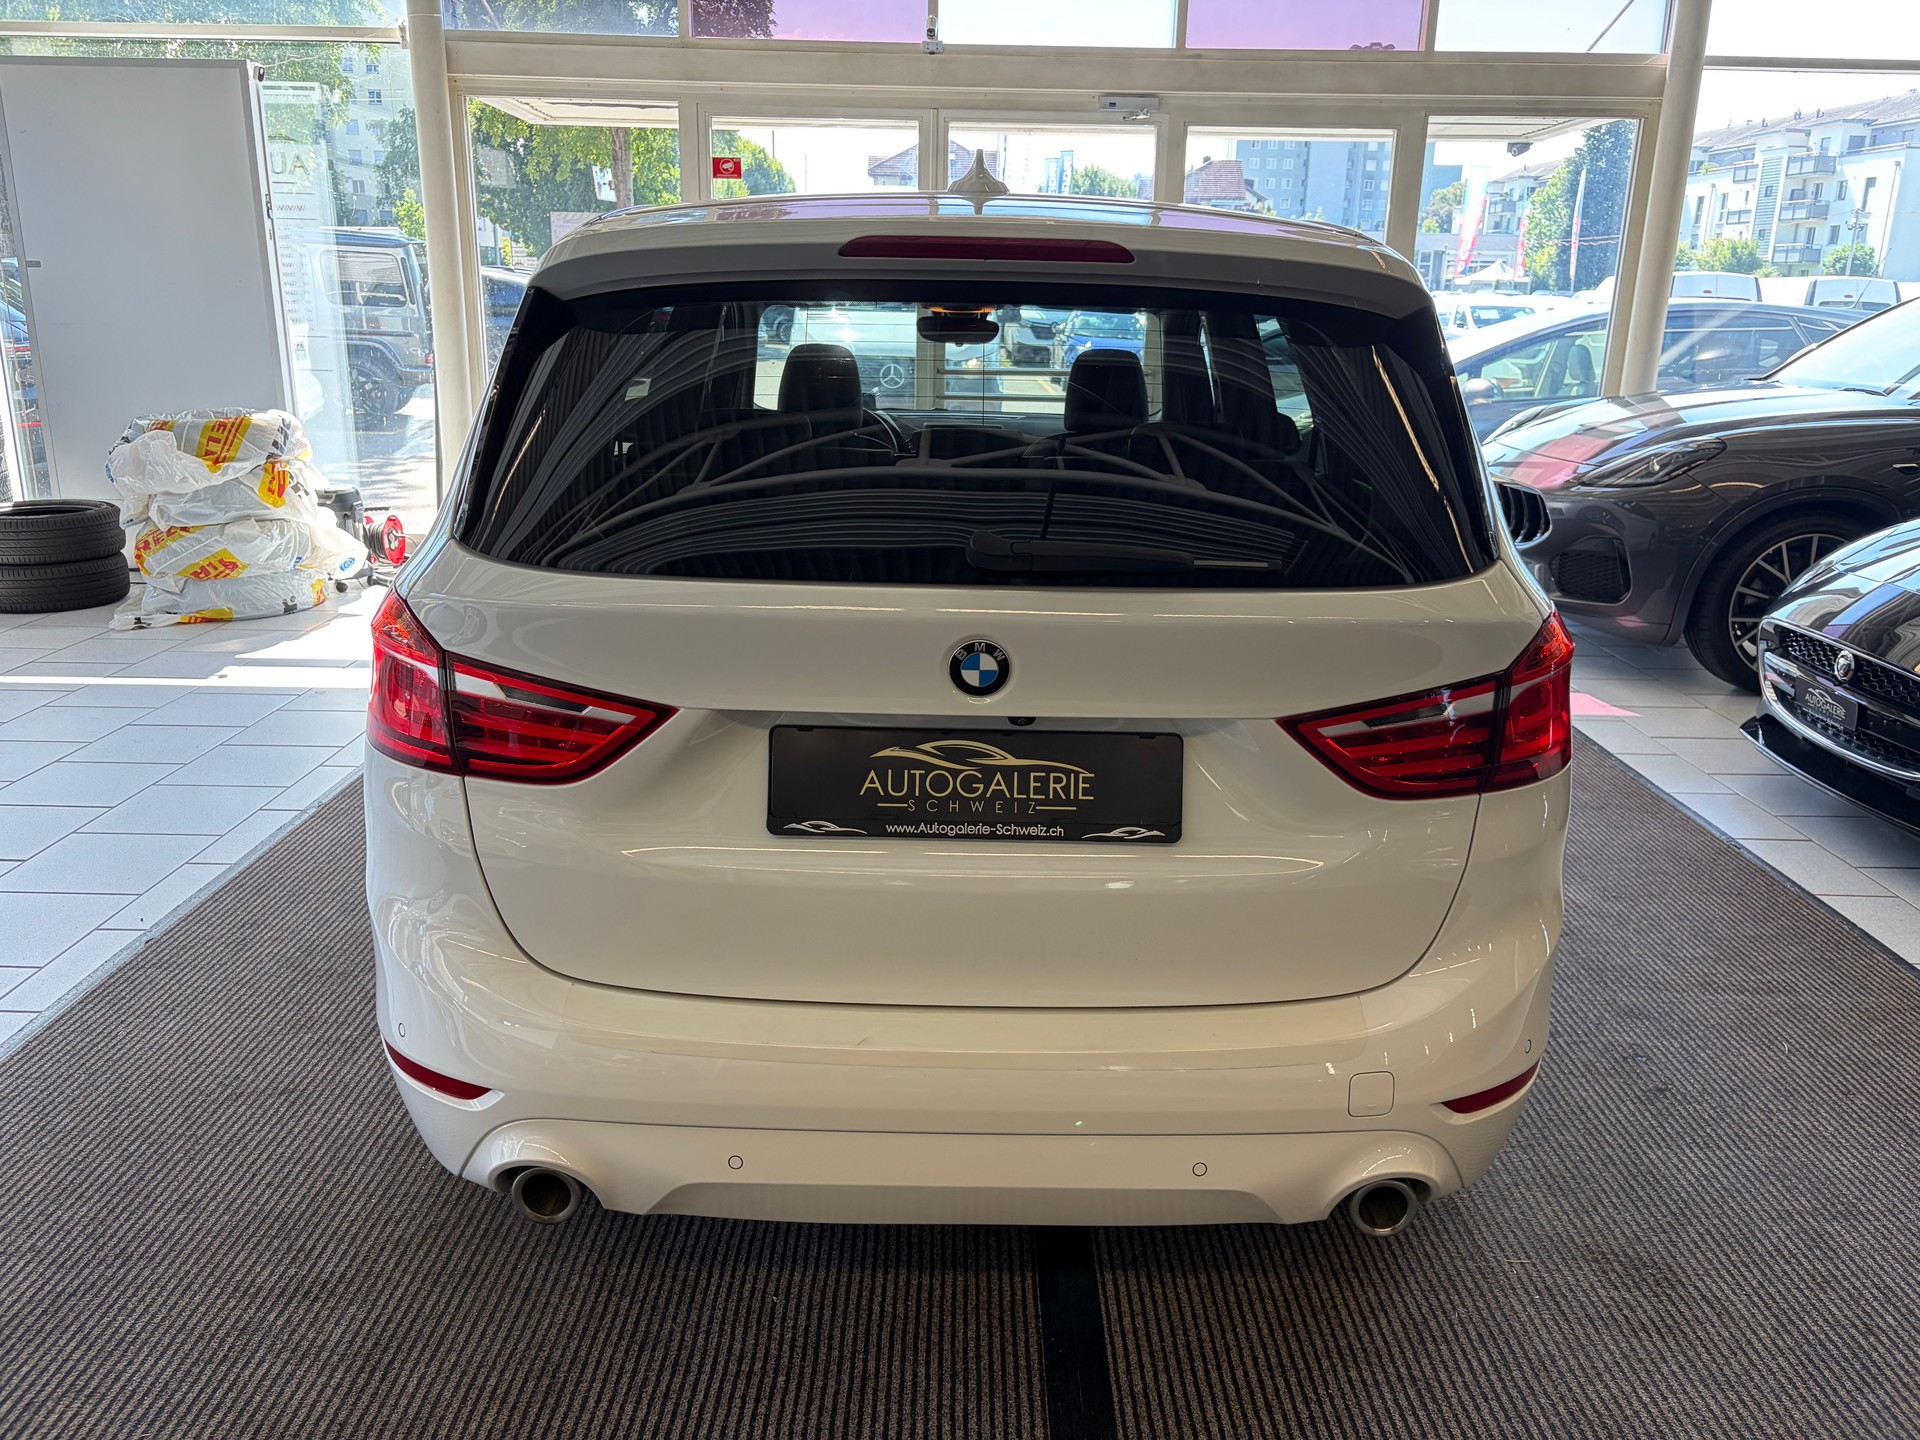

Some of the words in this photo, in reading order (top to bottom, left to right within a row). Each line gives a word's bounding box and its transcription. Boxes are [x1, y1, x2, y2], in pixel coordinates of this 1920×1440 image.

[954, 642, 1006, 662] BMW
[1805, 694, 1846, 719] AUTOGALERIE
[859, 768, 1095, 800] AUTOGALERIE
[907, 798, 1037, 814] SCHWEIZ
[885, 822, 1065, 838] www.Autogalerie-Schweiz.ch
